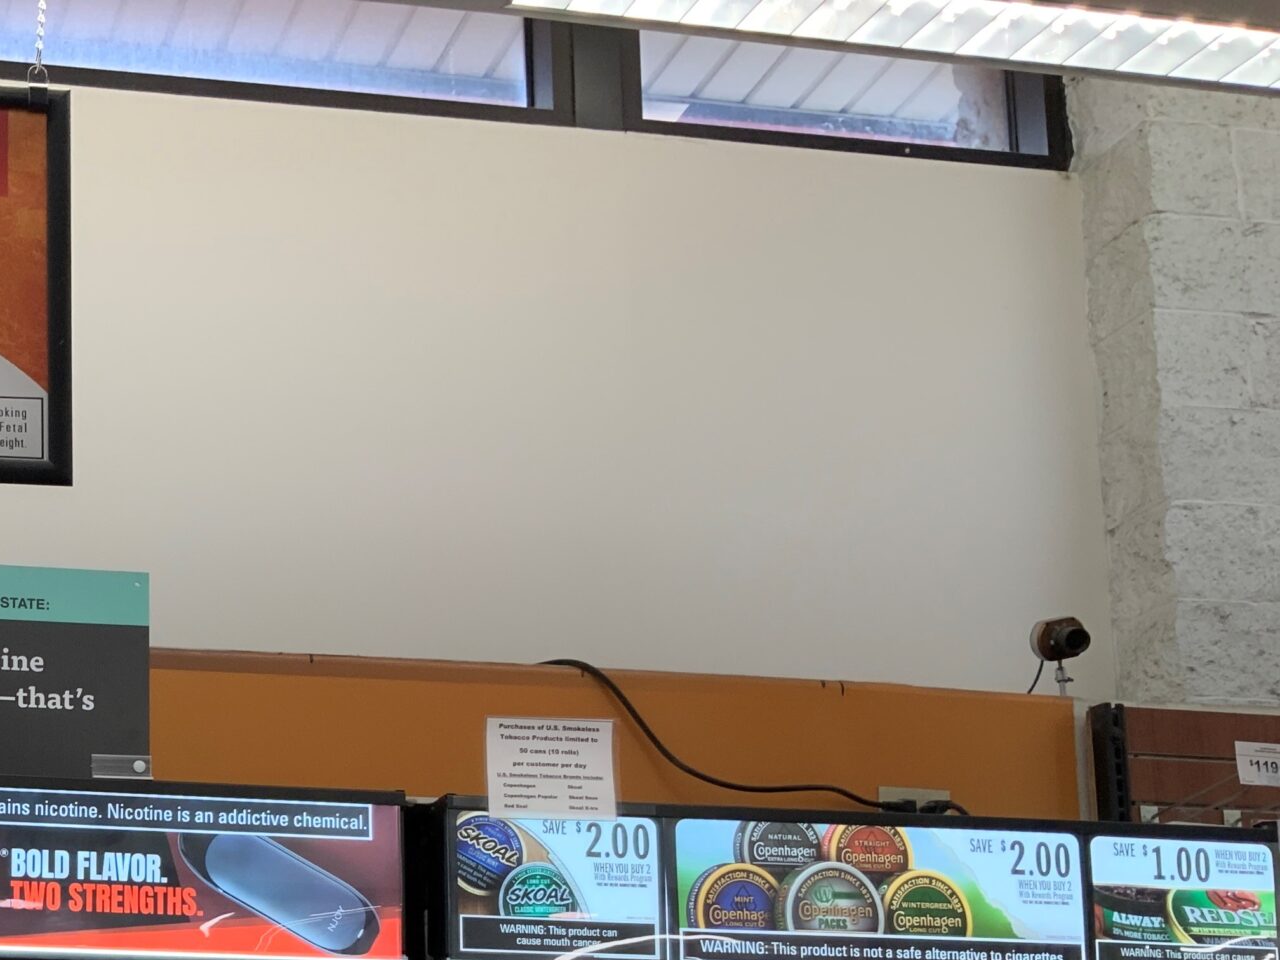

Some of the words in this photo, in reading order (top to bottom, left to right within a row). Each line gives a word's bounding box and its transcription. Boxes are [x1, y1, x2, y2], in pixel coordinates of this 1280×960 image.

[0, 422, 27, 433] Fetal
[0, 597, 50, 610] STATE:
[35, 800, 102, 819] nicotine.
[108, 803, 172, 822] Nicotine
[178, 806, 190, 822] is
[195, 810, 213, 823] an
[219, 809, 288, 826] addictive
[294, 811, 367, 830] chemical.
[970, 838, 992, 854] SAVE
[1113, 842, 1135, 857] SAVE
[10, 848, 70, 879] BOLD
[77, 851, 168, 883] FLAVOR.
[10, 881, 61, 911] TWO
[69, 883, 204, 916] STRENGTHS.
[701, 939, 768, 955] WARNING:
[771, 942, 797, 956] This
[801, 943, 847, 959] product
[850, 945, 860, 957] is
[863, 946, 882, 958] not
[886, 950, 892, 959] a
[896, 947, 921, 960] safe
